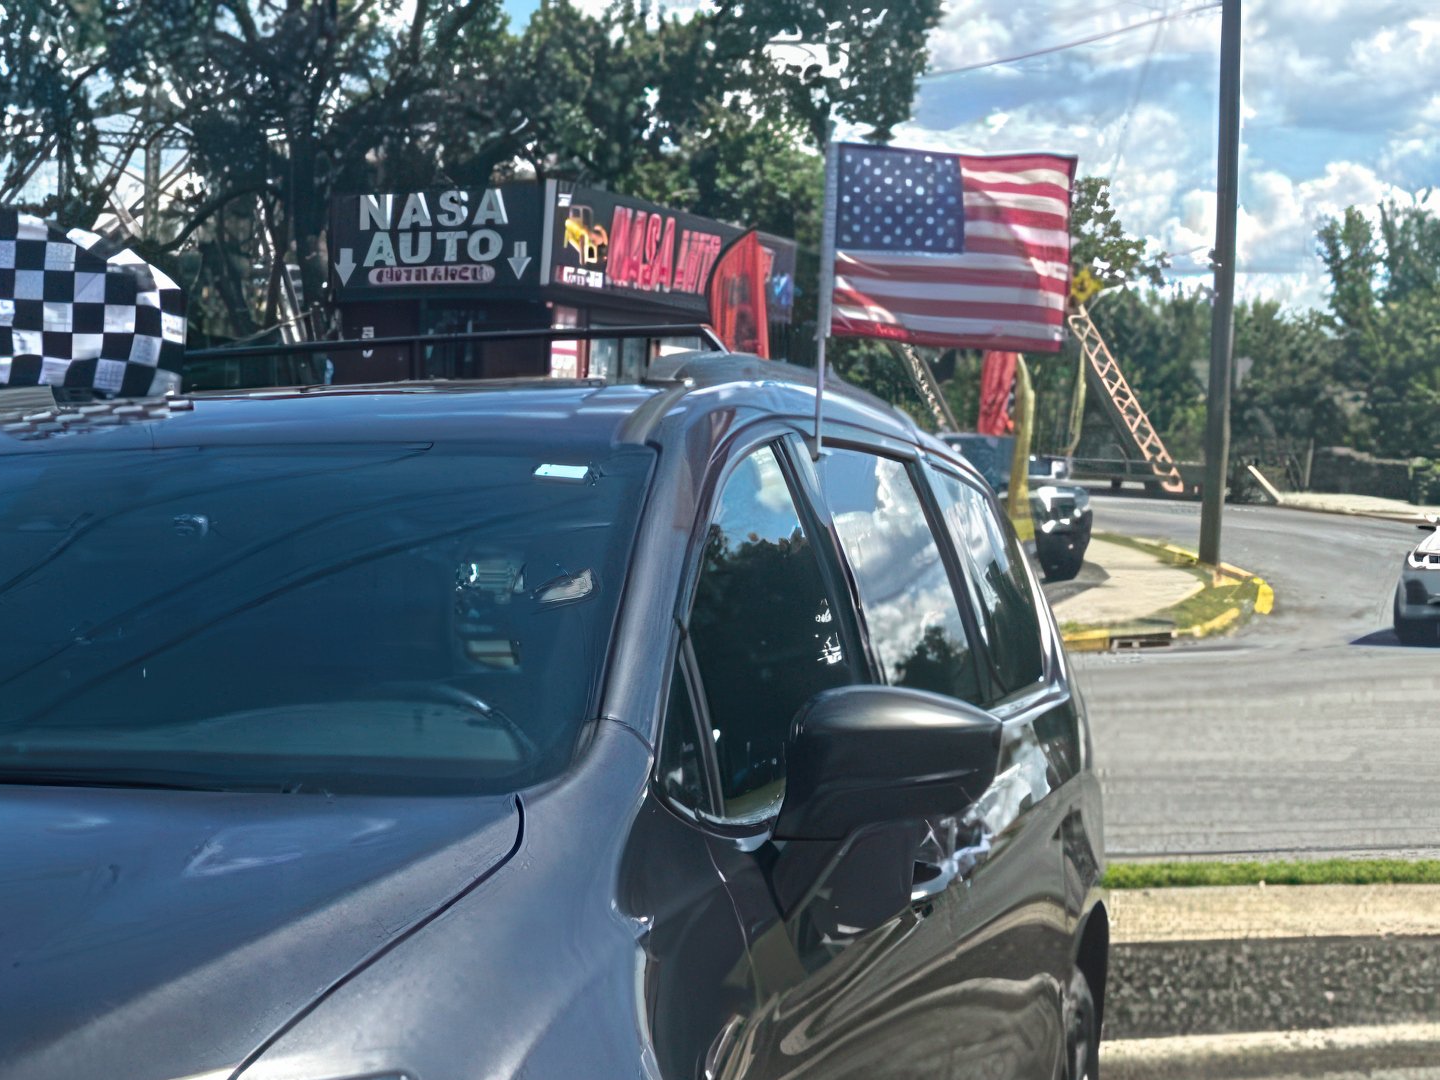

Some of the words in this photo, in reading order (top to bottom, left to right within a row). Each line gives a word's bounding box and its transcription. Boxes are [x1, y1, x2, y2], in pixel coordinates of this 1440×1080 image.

[359, 188, 508, 231] NASA
[362, 228, 504, 267] AUTO
[606, 205, 676, 293] NASA
